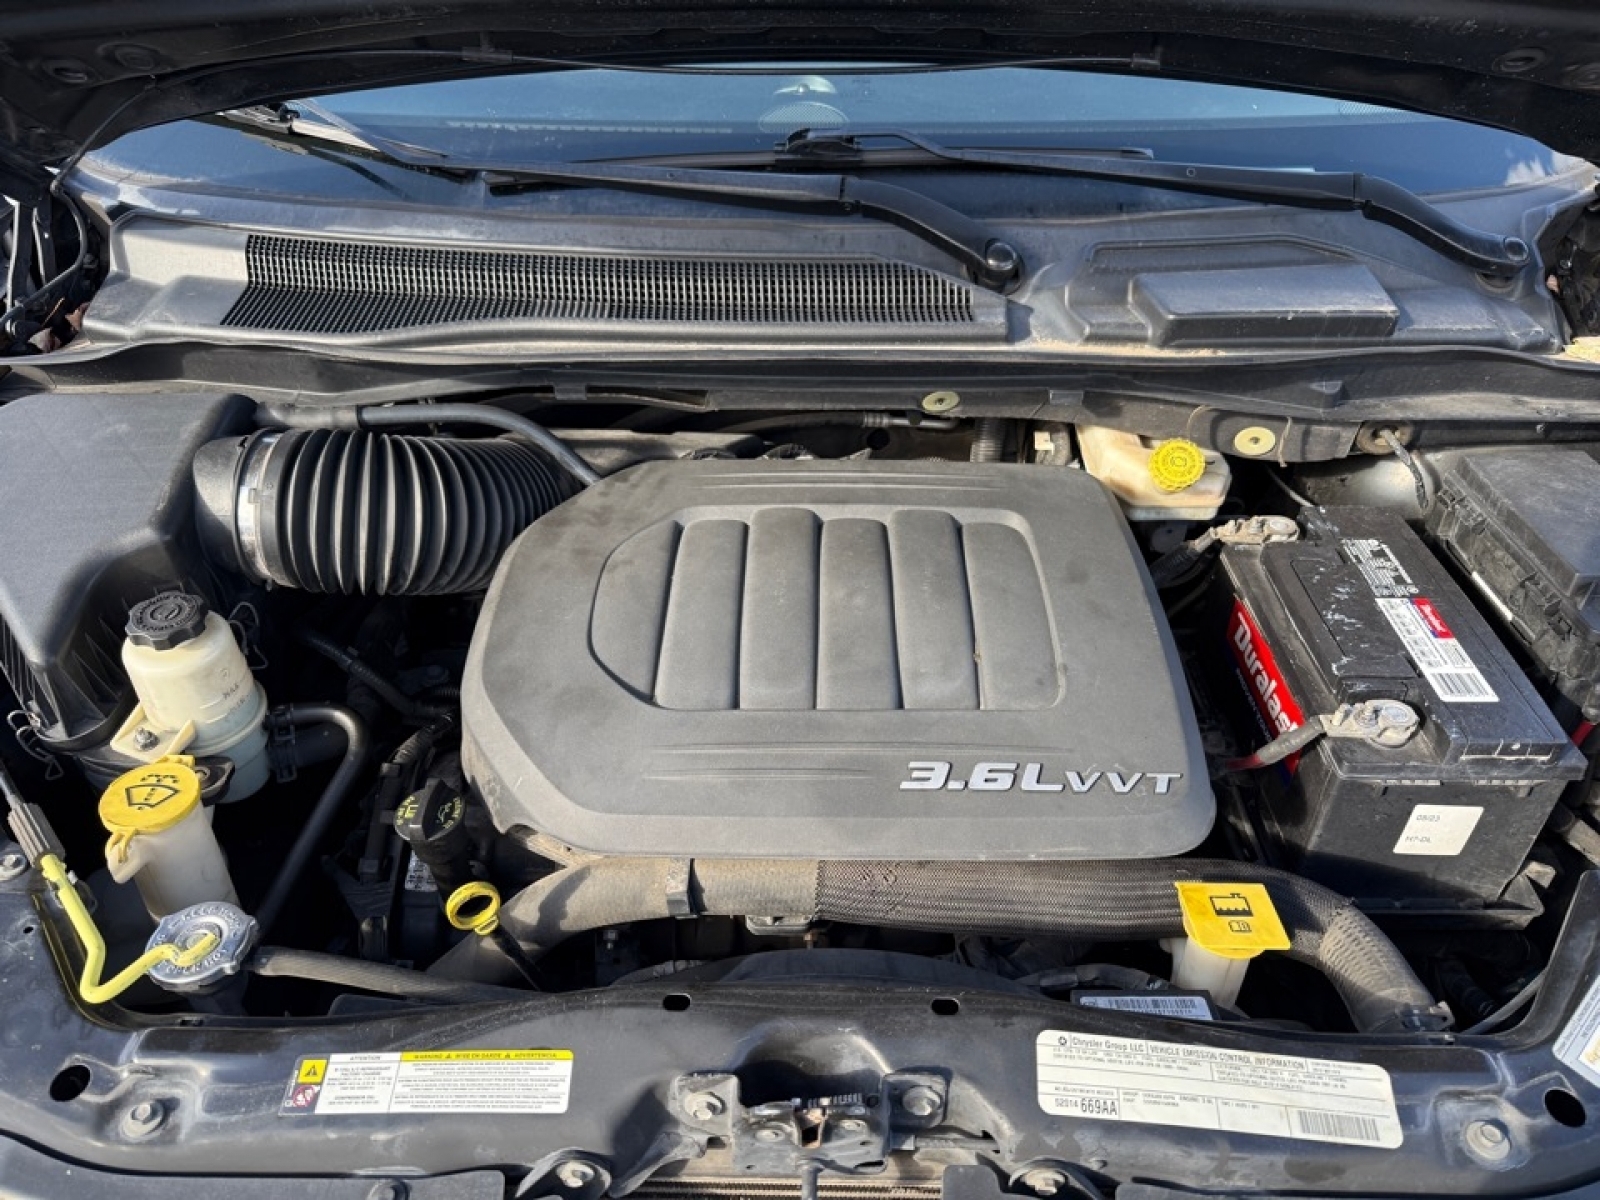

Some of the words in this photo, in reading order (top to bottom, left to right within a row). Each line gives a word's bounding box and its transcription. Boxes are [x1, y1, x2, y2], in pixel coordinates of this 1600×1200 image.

[899, 760, 1066, 792] 3.6L
[1064, 770, 1184, 795] VVT
[1072, 1036, 1103, 1049] Chrysler
[1104, 1040, 1128, 1052] Group
[1129, 1042, 1144, 1053] LLC
[1149, 1044, 1180, 1056] VEHICLE
[1182, 1048, 1218, 1060] EMISSION
[1219, 1052, 1253, 1064] CONTROL
[1254, 1056, 1304, 1069] INFORMATION
[1081, 1098, 1118, 1116] 669AA
